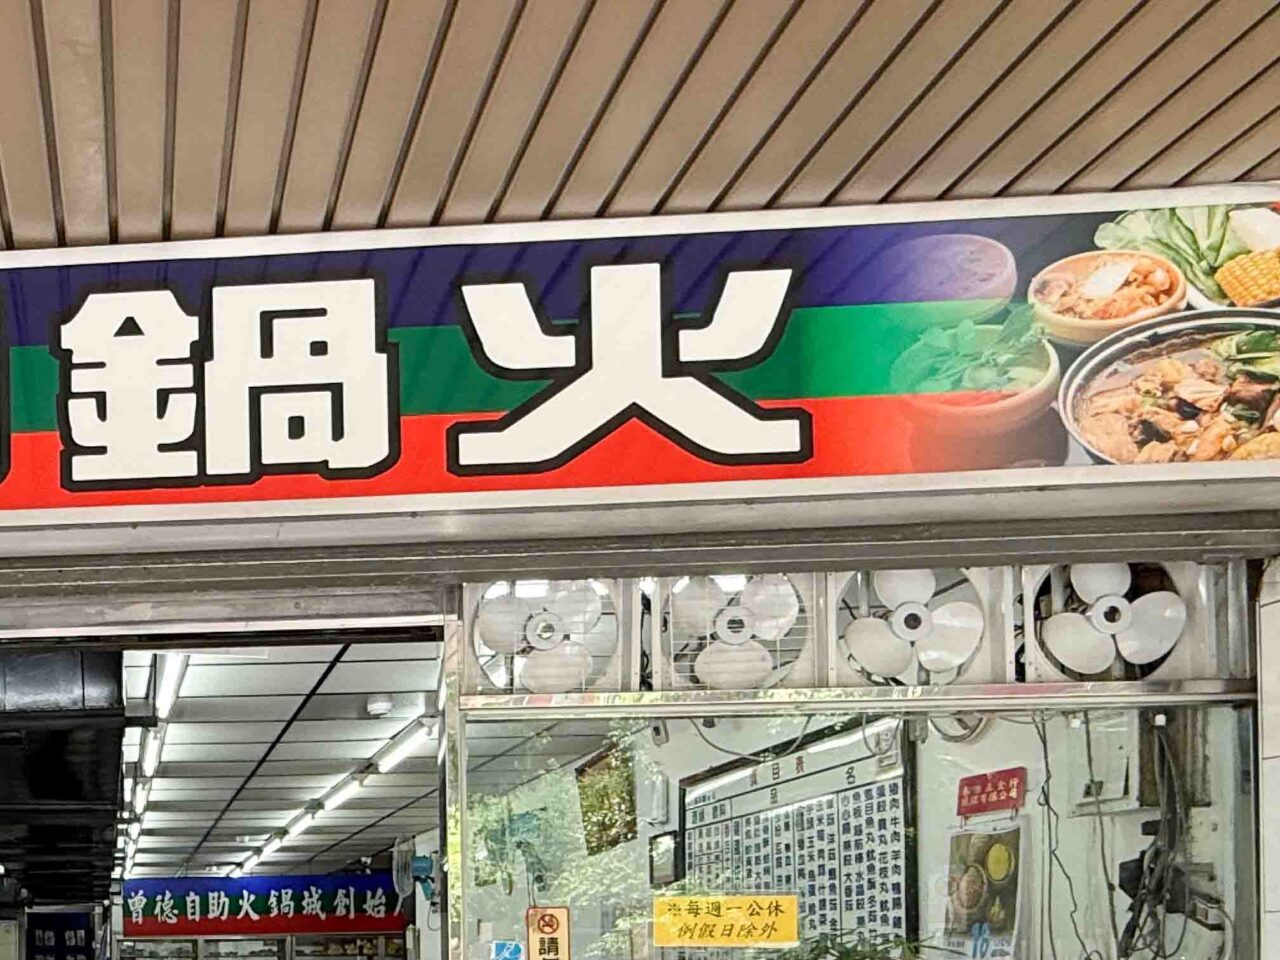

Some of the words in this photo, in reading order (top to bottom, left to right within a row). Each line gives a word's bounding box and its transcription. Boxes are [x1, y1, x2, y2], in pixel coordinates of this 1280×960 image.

[677, 920, 778, 940] 例假日除外
